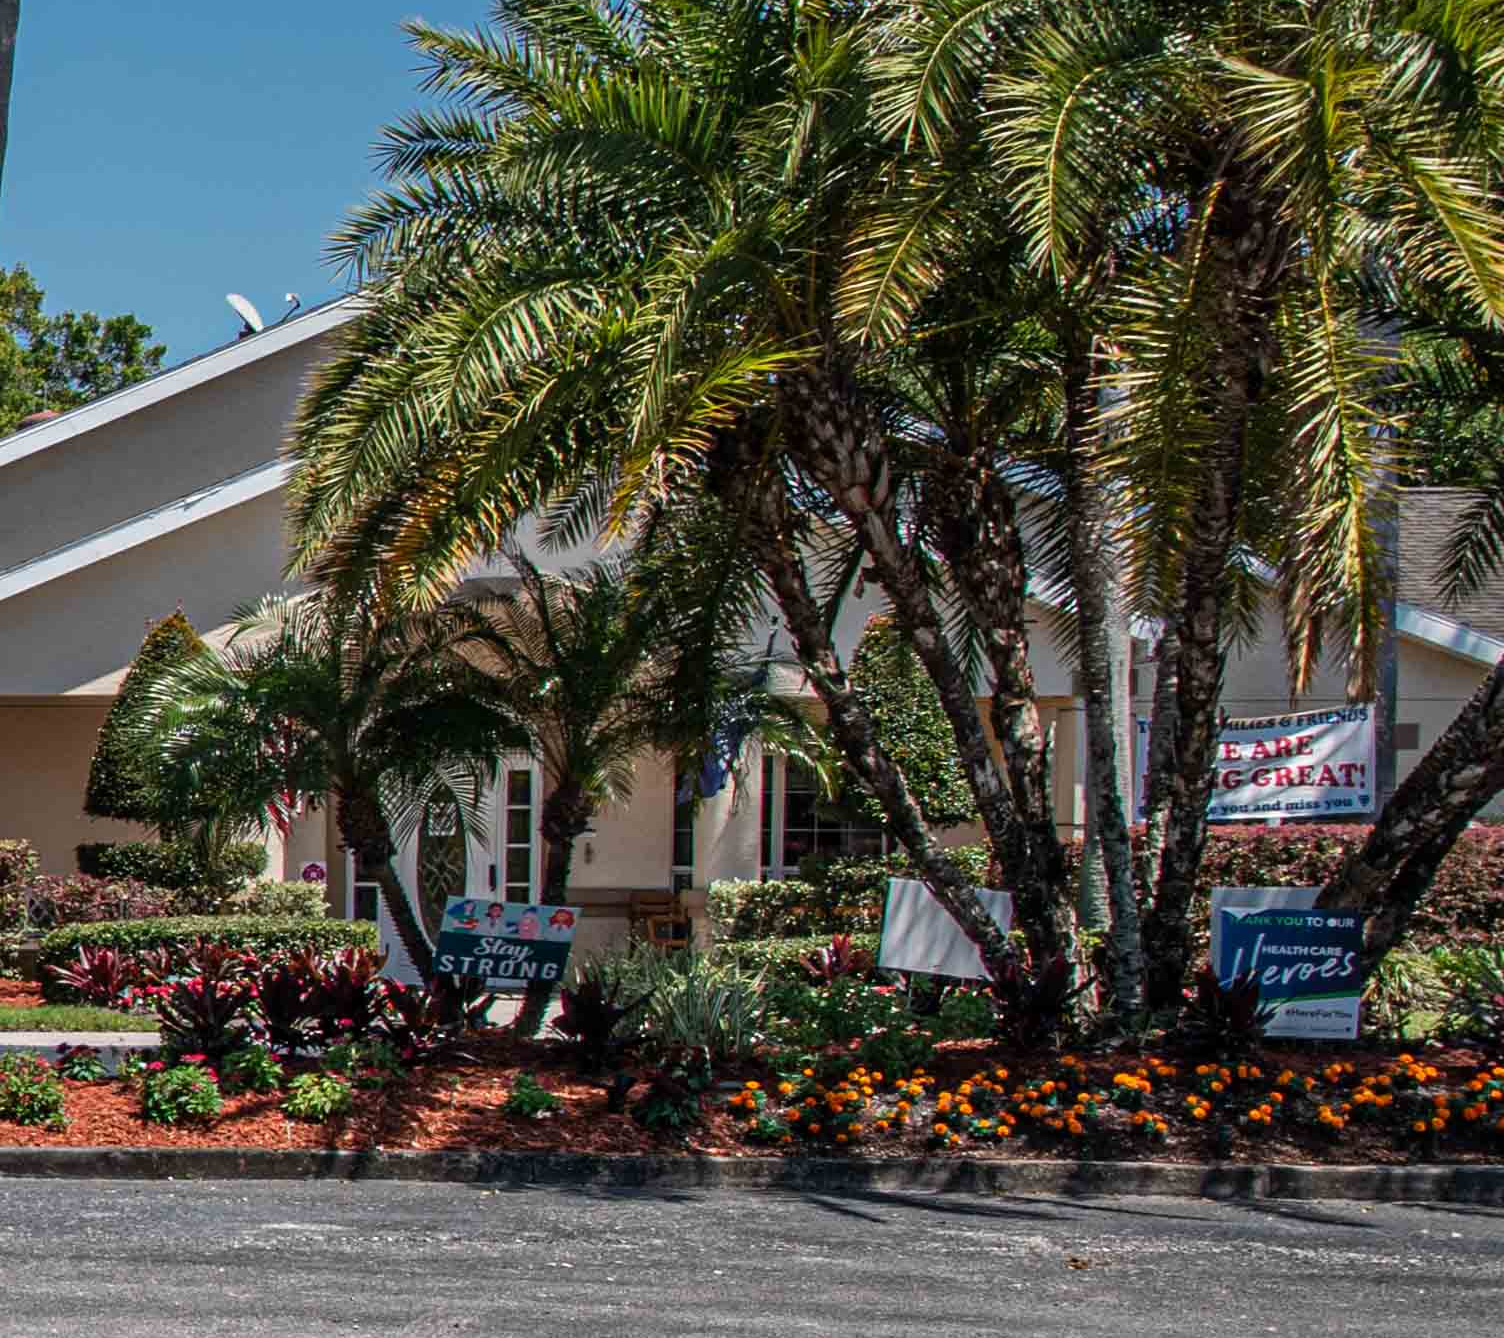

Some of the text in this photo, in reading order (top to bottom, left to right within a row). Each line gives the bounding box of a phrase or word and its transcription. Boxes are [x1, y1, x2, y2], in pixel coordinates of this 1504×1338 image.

[1296, 708, 1369, 727] FRIENDS
[1250, 735, 1313, 760] ARE
[1250, 763, 1367, 789] GREAT!
[1221, 804, 1250, 817] you
[1252, 799, 1281, 812] and
[1284, 799, 1320, 811] miss
[1324, 797, 1353, 811] you
[1276, 916, 1303, 926] YOU
[1305, 917, 1323, 927] TO
[473, 937, 535, 963] Stay
[1218, 933, 1357, 990] Heroes
[438, 954, 560, 979] STRONG
